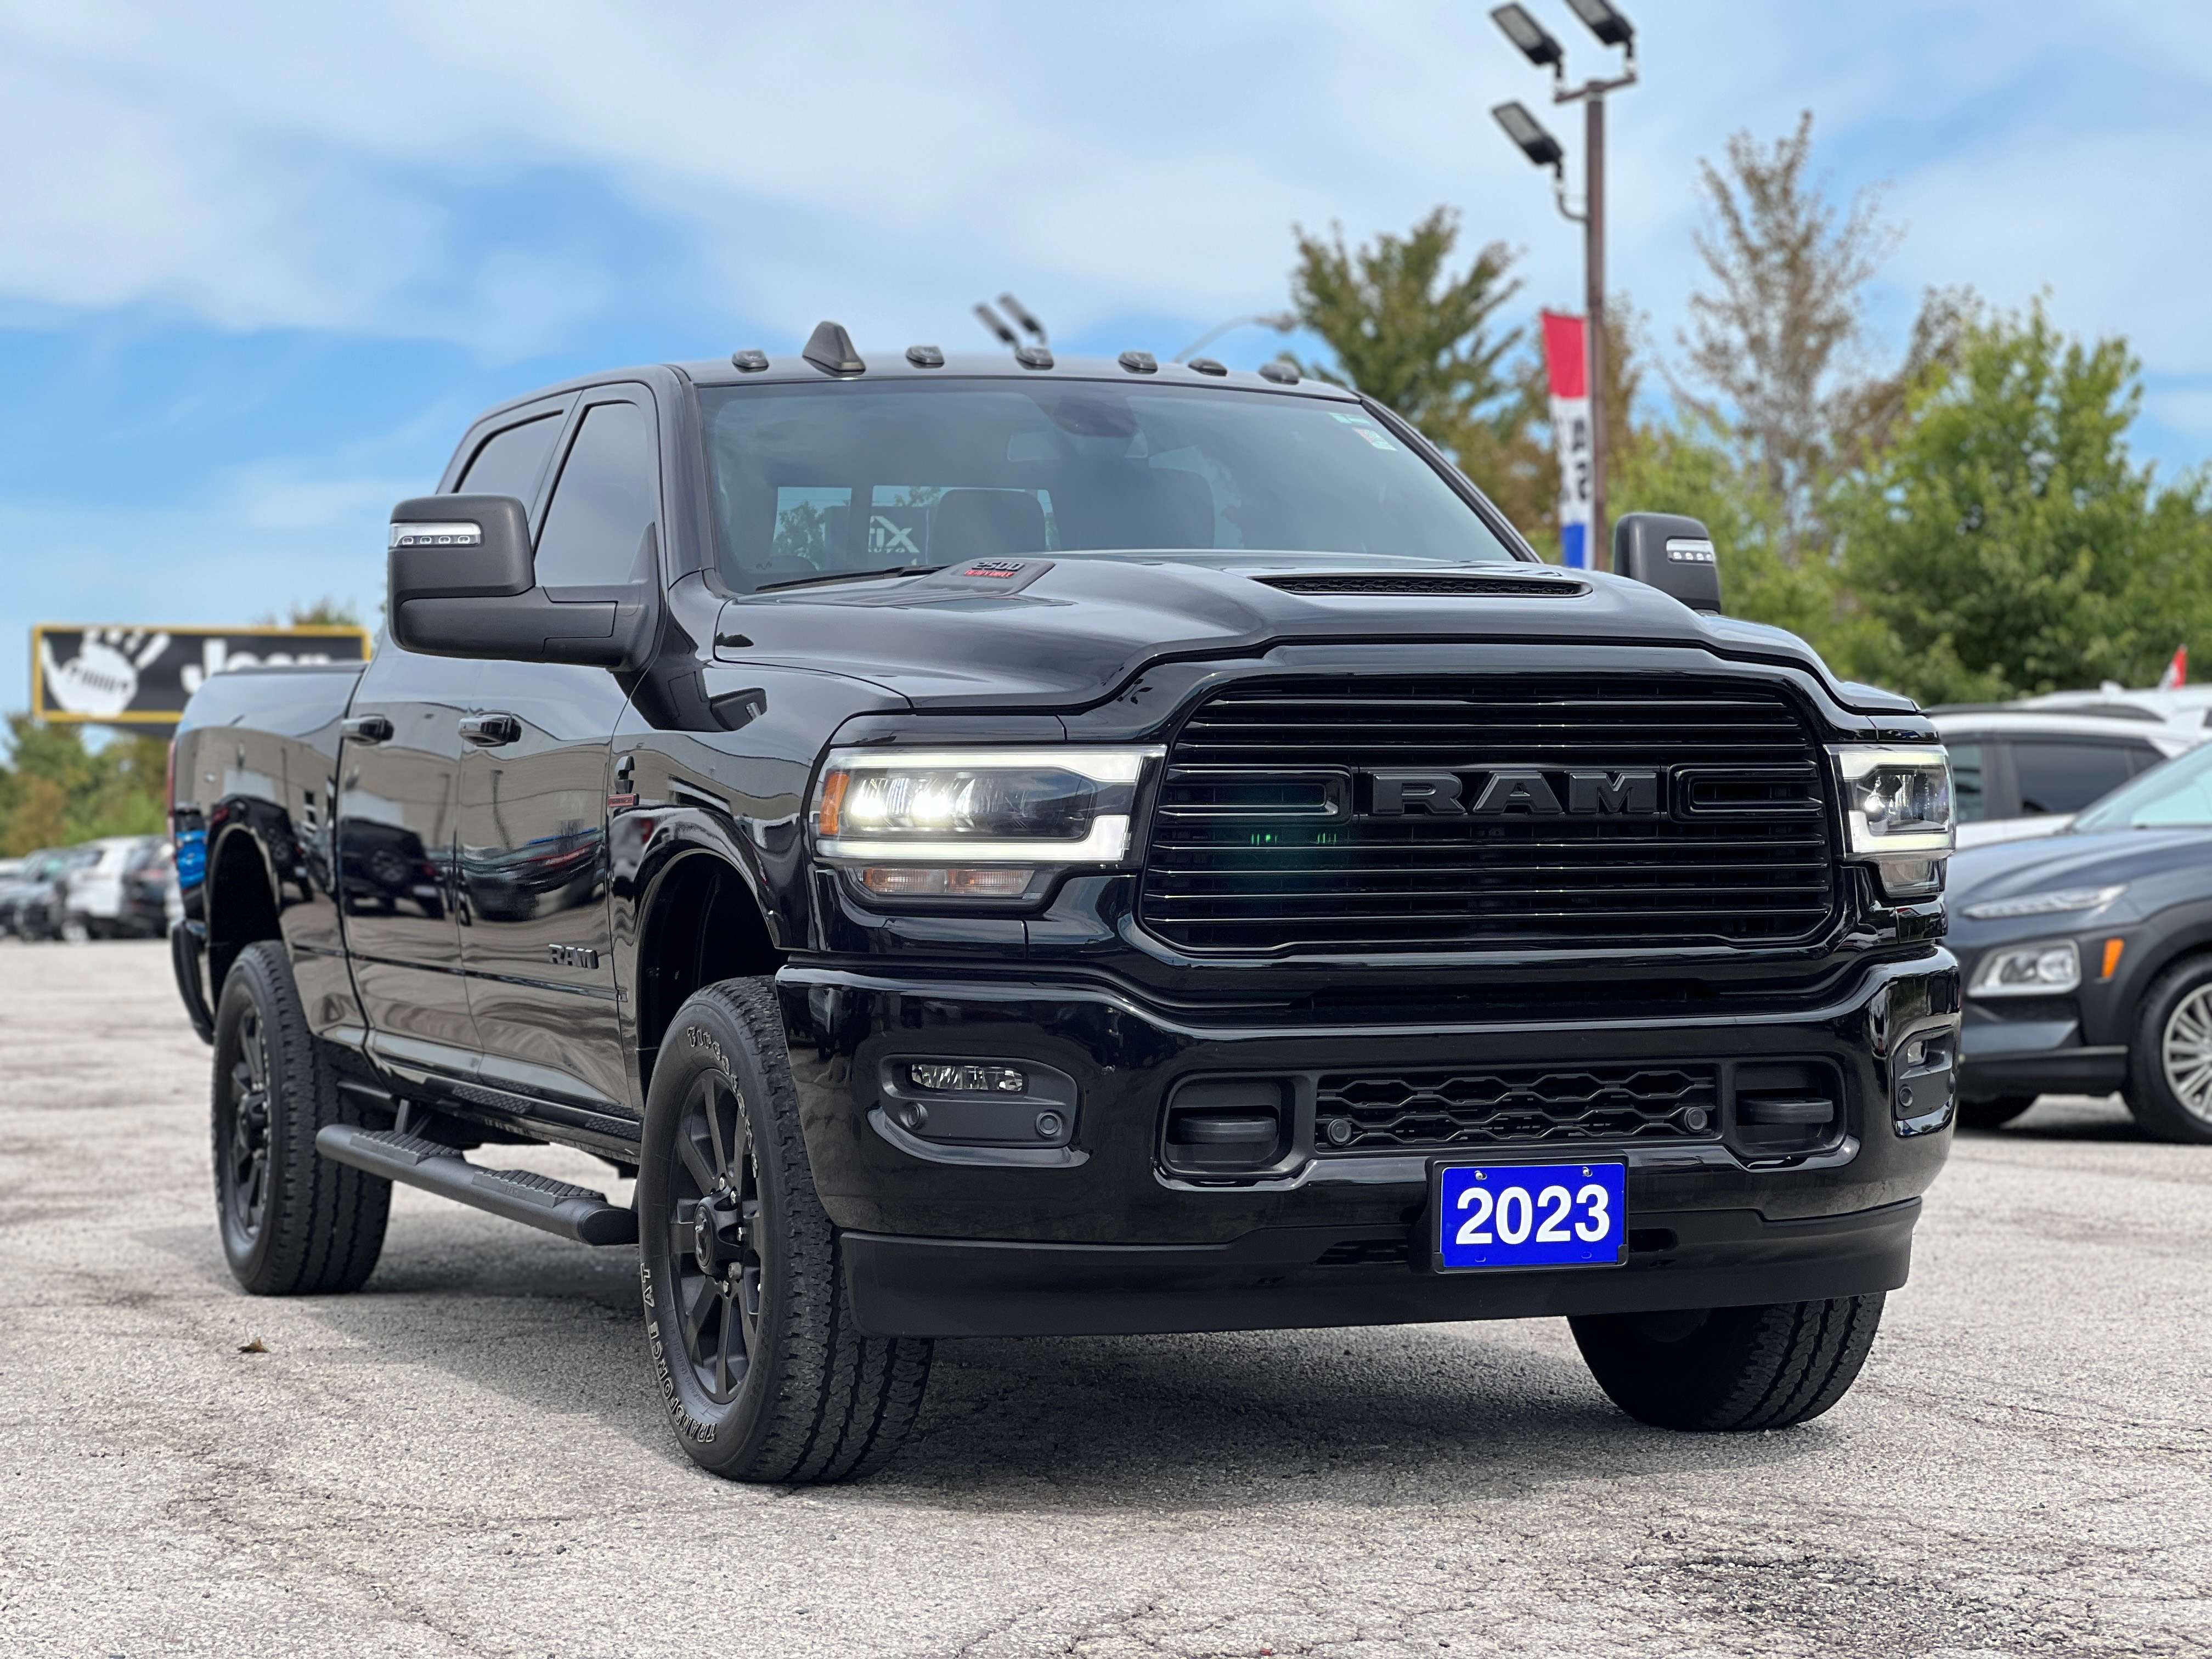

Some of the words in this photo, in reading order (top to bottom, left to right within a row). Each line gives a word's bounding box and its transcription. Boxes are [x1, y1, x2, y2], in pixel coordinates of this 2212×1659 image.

[972, 562, 1025, 571] 2500
[1373, 772, 1657, 815] RAM
[548, 944, 599, 969] RAM
[1455, 1184, 1610, 1245] 2023
[640, 1262, 655, 1308] AT
[647, 1321, 717, 1443] TRANSFORCE
